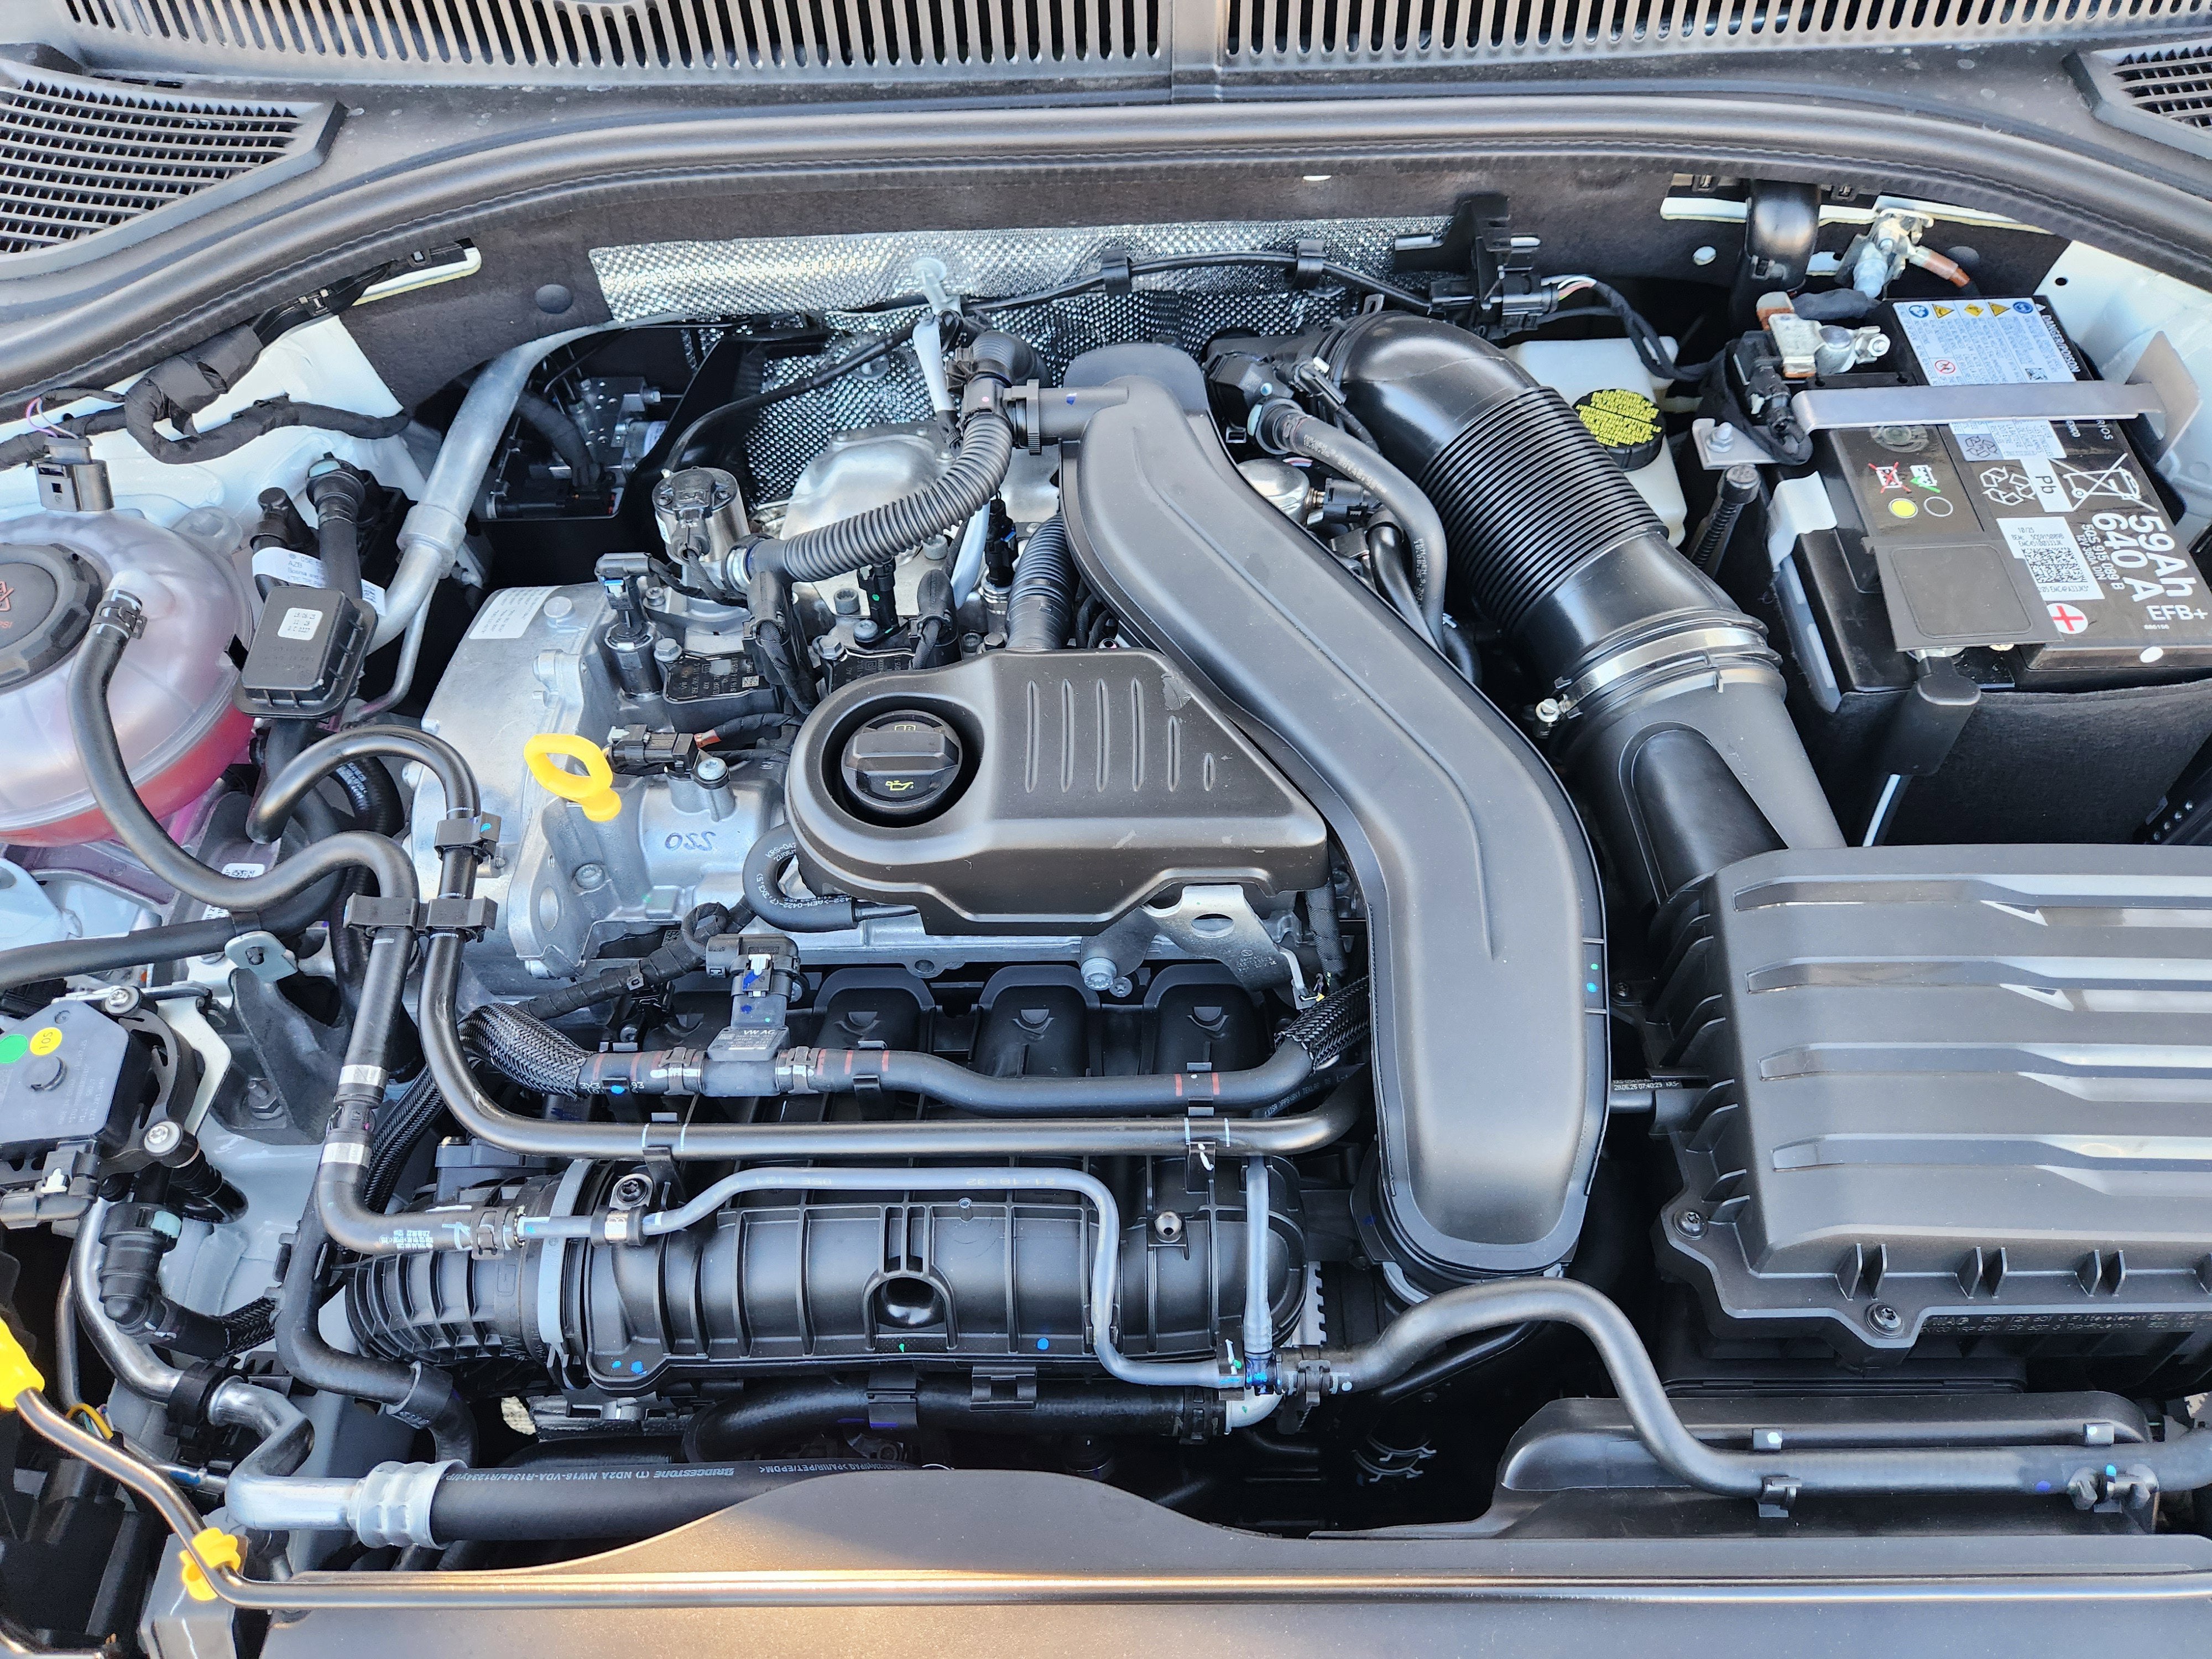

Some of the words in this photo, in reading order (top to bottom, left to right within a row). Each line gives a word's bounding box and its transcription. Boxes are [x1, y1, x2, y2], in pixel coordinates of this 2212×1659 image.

[2042, 315, 2081, 373] DANGER/POISON
[2035, 476, 2057, 494] Pb
[2092, 513, 2148, 568] 640
[2122, 577, 2164, 602] A
[2093, 545, 2110, 561] 915
[2128, 514, 2197, 597] 59Ah
[2083, 547, 2099, 566] 380A
[2091, 566, 2107, 581] DIN
[2101, 562, 2120, 581] 089
[2110, 582, 2126, 590] B
[2146, 604, 2208, 621] EFB+
[601, 1471, 633, 1480] ND2A
[635, 1470, 650, 1479] (T)
[653, 1468, 735, 1479] BRIDGESTONE
